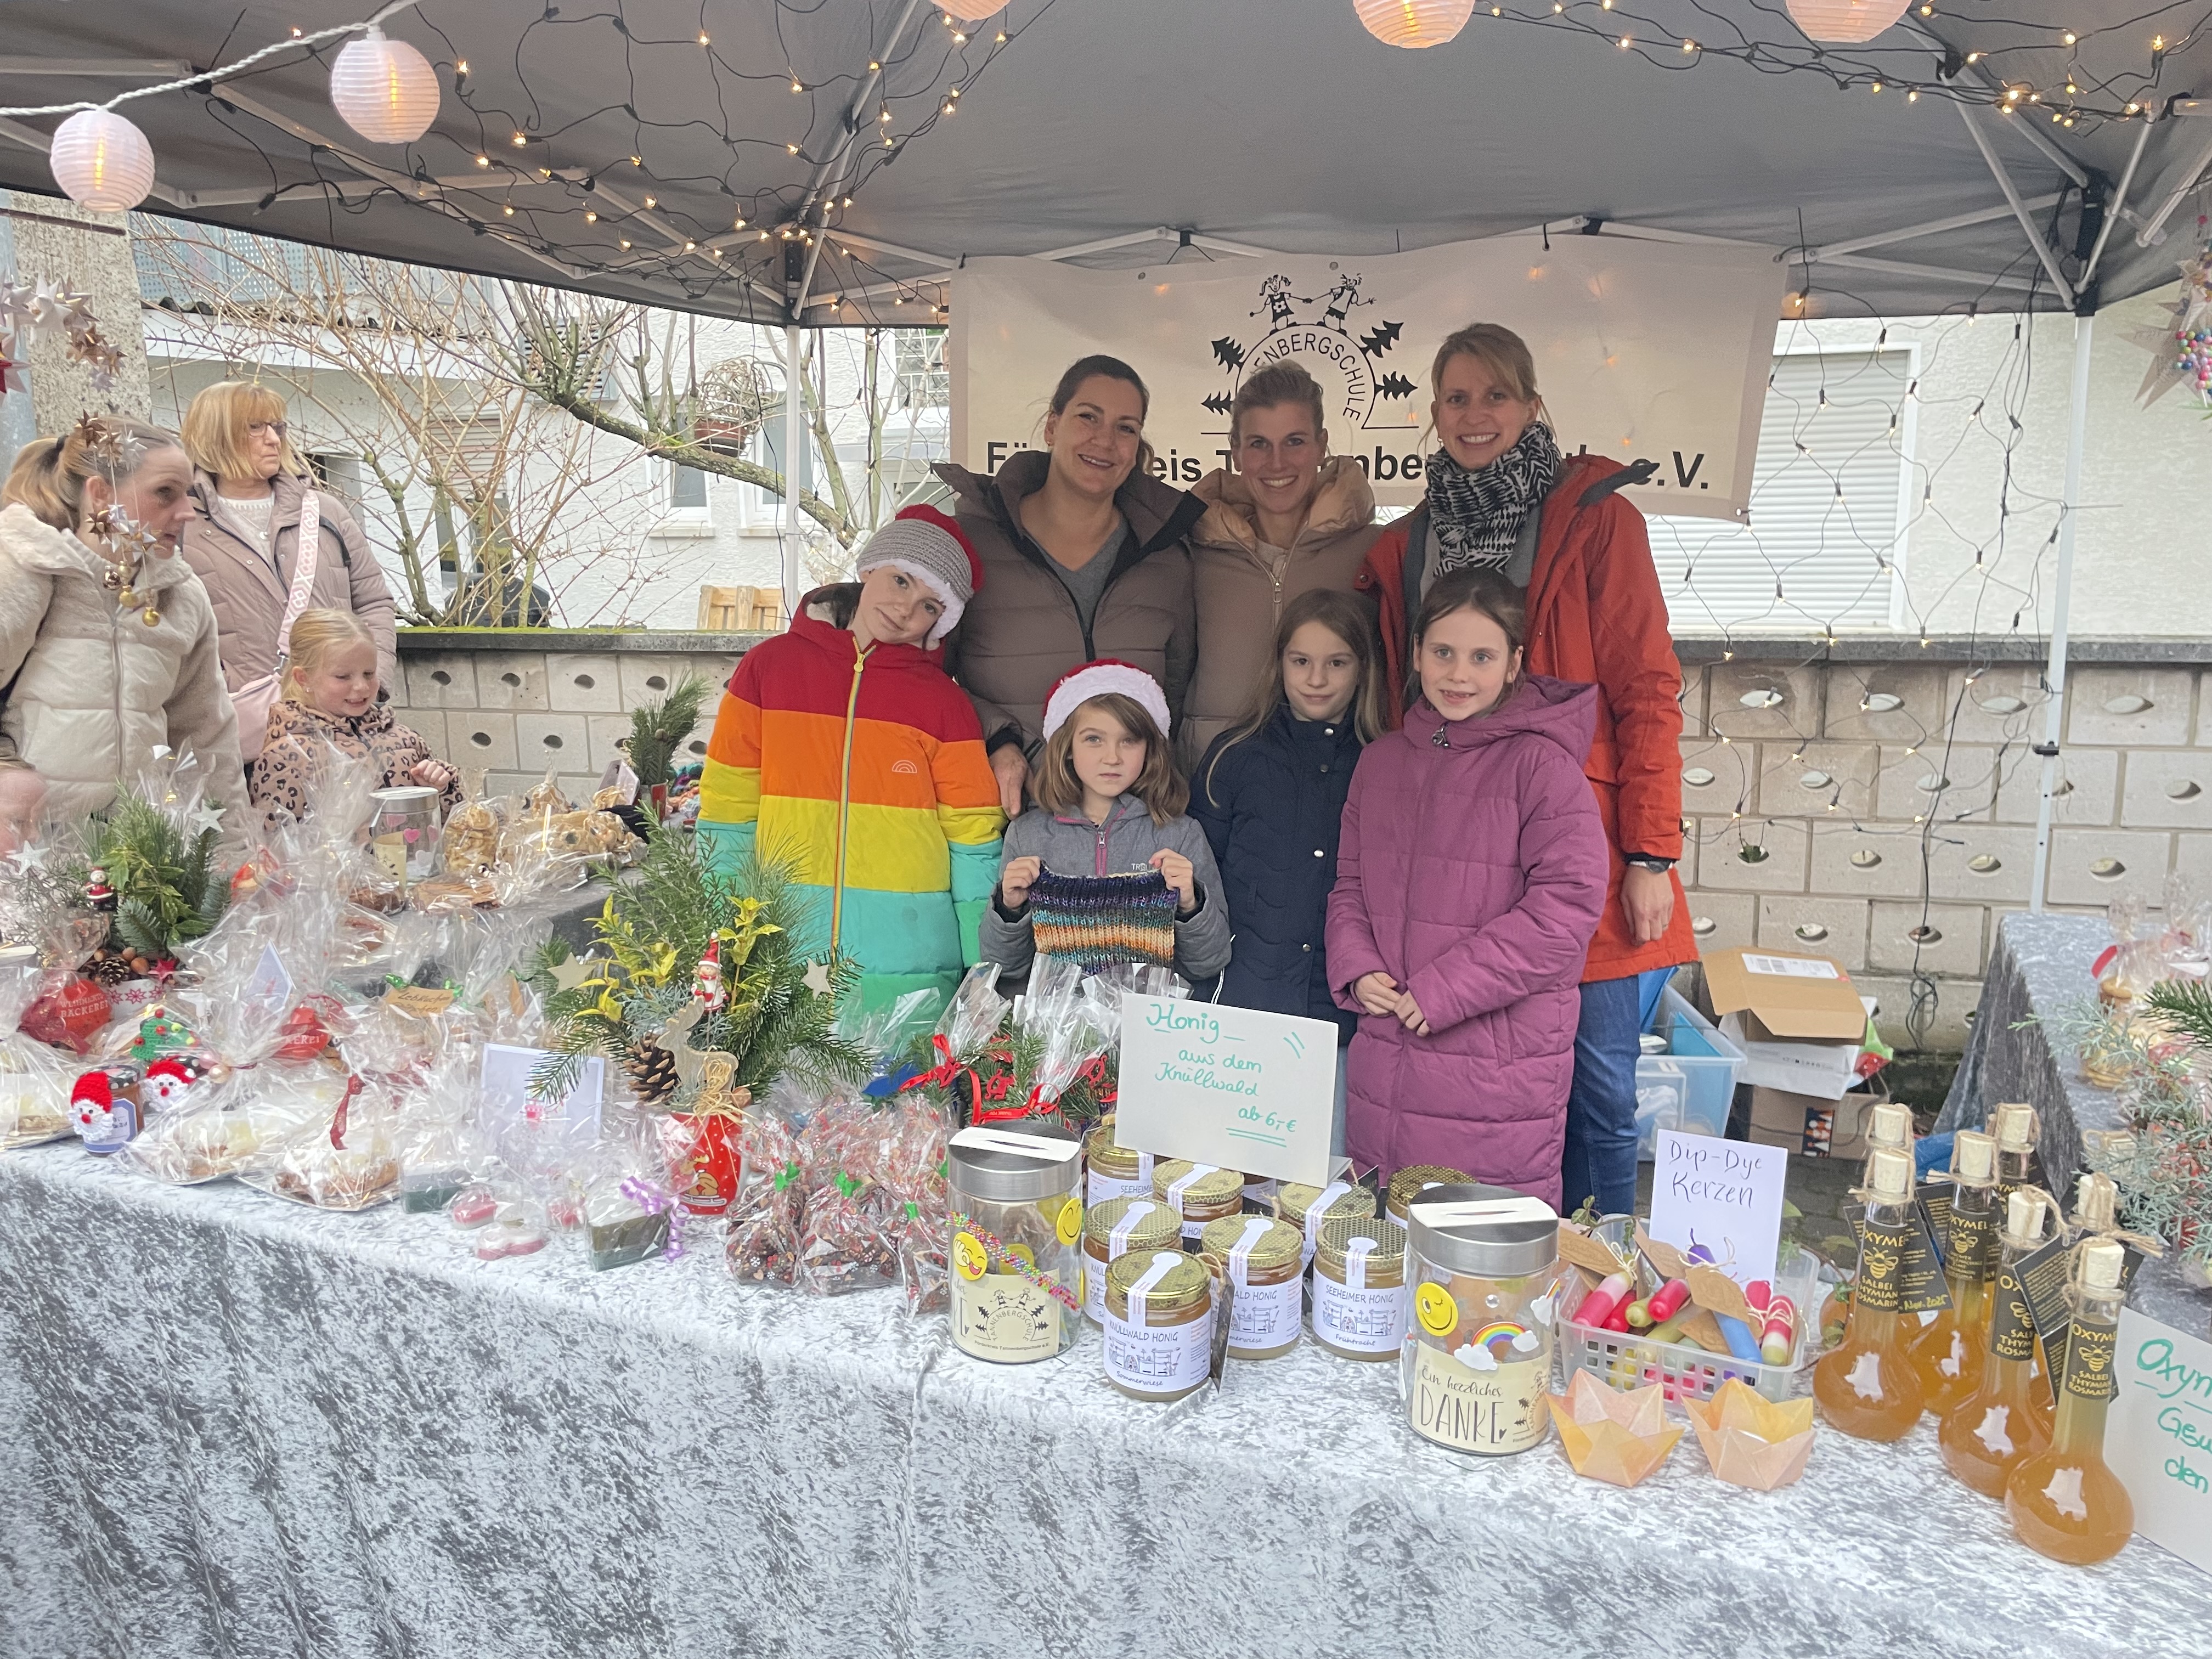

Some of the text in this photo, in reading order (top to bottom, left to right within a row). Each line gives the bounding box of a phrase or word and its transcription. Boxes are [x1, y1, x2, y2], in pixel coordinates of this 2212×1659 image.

[1253, 332, 1367, 422] NBERGSCHULE
[1146, 1003, 1220, 1043] Honig
[1155, 1062, 1259, 1097] Knüllwald
[1178, 1049, 1262, 1074] aus dem
[1238, 1106, 1263, 1121] ab
[1669, 1139, 1763, 1180] Dip-Dye
[1673, 1171, 1752, 1209] Kerzen
[1252, 1290, 1278, 1301] HONIG
[1325, 1284, 1395, 1305] SEEHEIMER HONIG
[1109, 1318, 1178, 1343] KNÜLLWALD HONIG
[1420, 1383, 1505, 1444] DANKE
[2164, 1455, 2209, 1494] den
